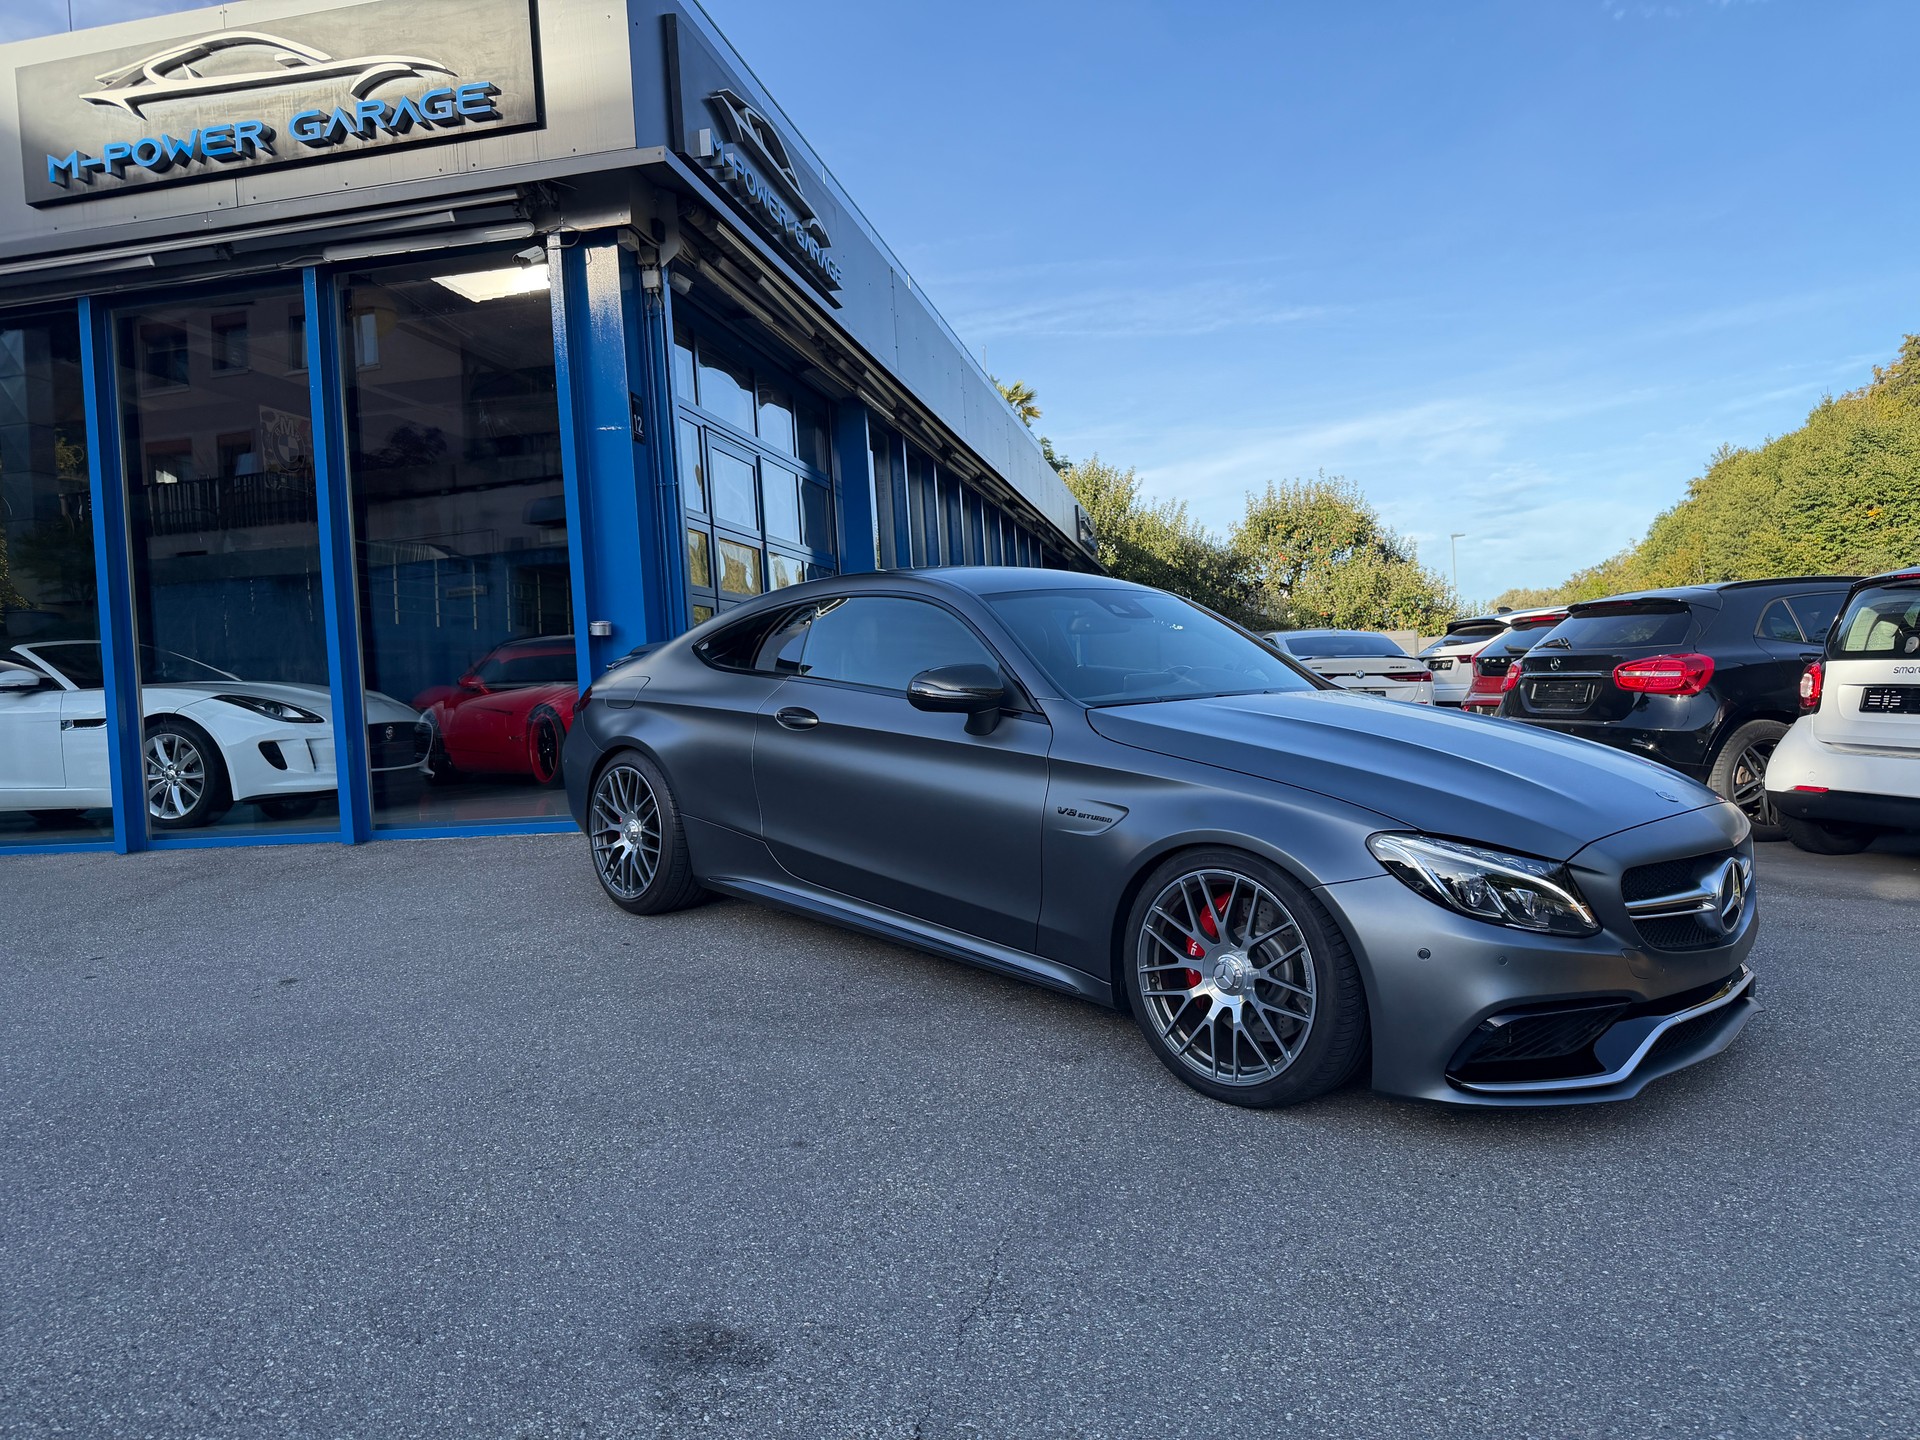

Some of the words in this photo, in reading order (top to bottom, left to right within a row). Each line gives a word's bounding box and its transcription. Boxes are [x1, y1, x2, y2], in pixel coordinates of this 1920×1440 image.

[47, 120, 266, 184] M-POWER
[289, 82, 495, 142] GARAGE
[709, 133, 789, 232] M-POWER
[794, 221, 843, 289] GARAGE
[634, 414, 643, 433] 12
[1893, 666, 1920, 674] smar
[1057, 806, 1077, 817] V8
[1078, 812, 1112, 823] BITURBO
